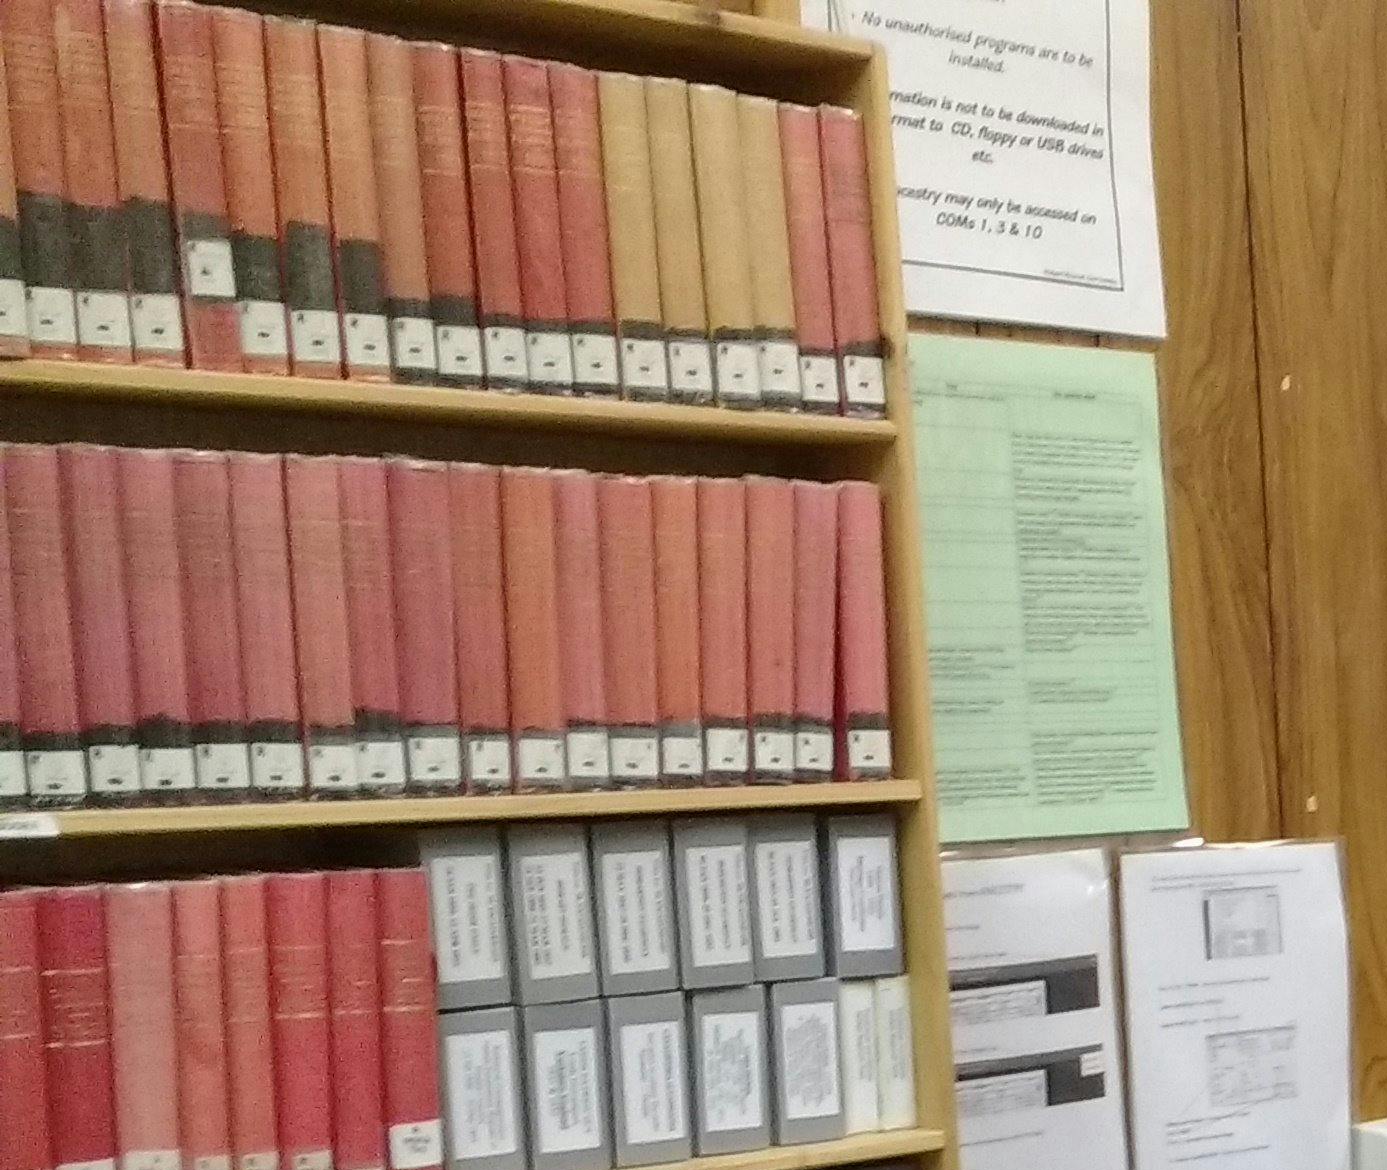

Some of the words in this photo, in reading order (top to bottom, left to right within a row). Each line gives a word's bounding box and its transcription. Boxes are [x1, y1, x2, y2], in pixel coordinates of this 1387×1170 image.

[861, 11, 881, 27] No
[885, 16, 973, 44] unauthorised
[973, 34, 1036, 57] programs
[1038, 47, 1058, 62] are
[1062, 50, 1076, 65] to
[1078, 53, 1094, 69] be
[889, 90, 938, 108] mation
[941, 95, 952, 110] is
[955, 100, 978, 116] not
[981, 104, 995, 118] to
[998, 107, 1013, 122] be
[1016, 110, 1090, 135] downloaded
[1092, 121, 1105, 137] in
[891, 113, 926, 130] rmat
[928, 118, 944, 133] to
[951, 121, 973, 139] CD,
[977, 125, 1017, 148] floppy
[1019, 135, 1034, 147] or
[1037, 135, 1066, 153] USB
[1067, 142, 1104, 160] drives
[935, 211, 975, 231] COMs
[1009, 220, 1020, 236] &
[1025, 223, 1043, 240] 10
[944, 192, 974, 209] may
[976, 195, 1004, 215] only
[1006, 198, 1021, 214] be
[1024, 204, 1078, 223] accessed
[1080, 213, 1097, 226] on
